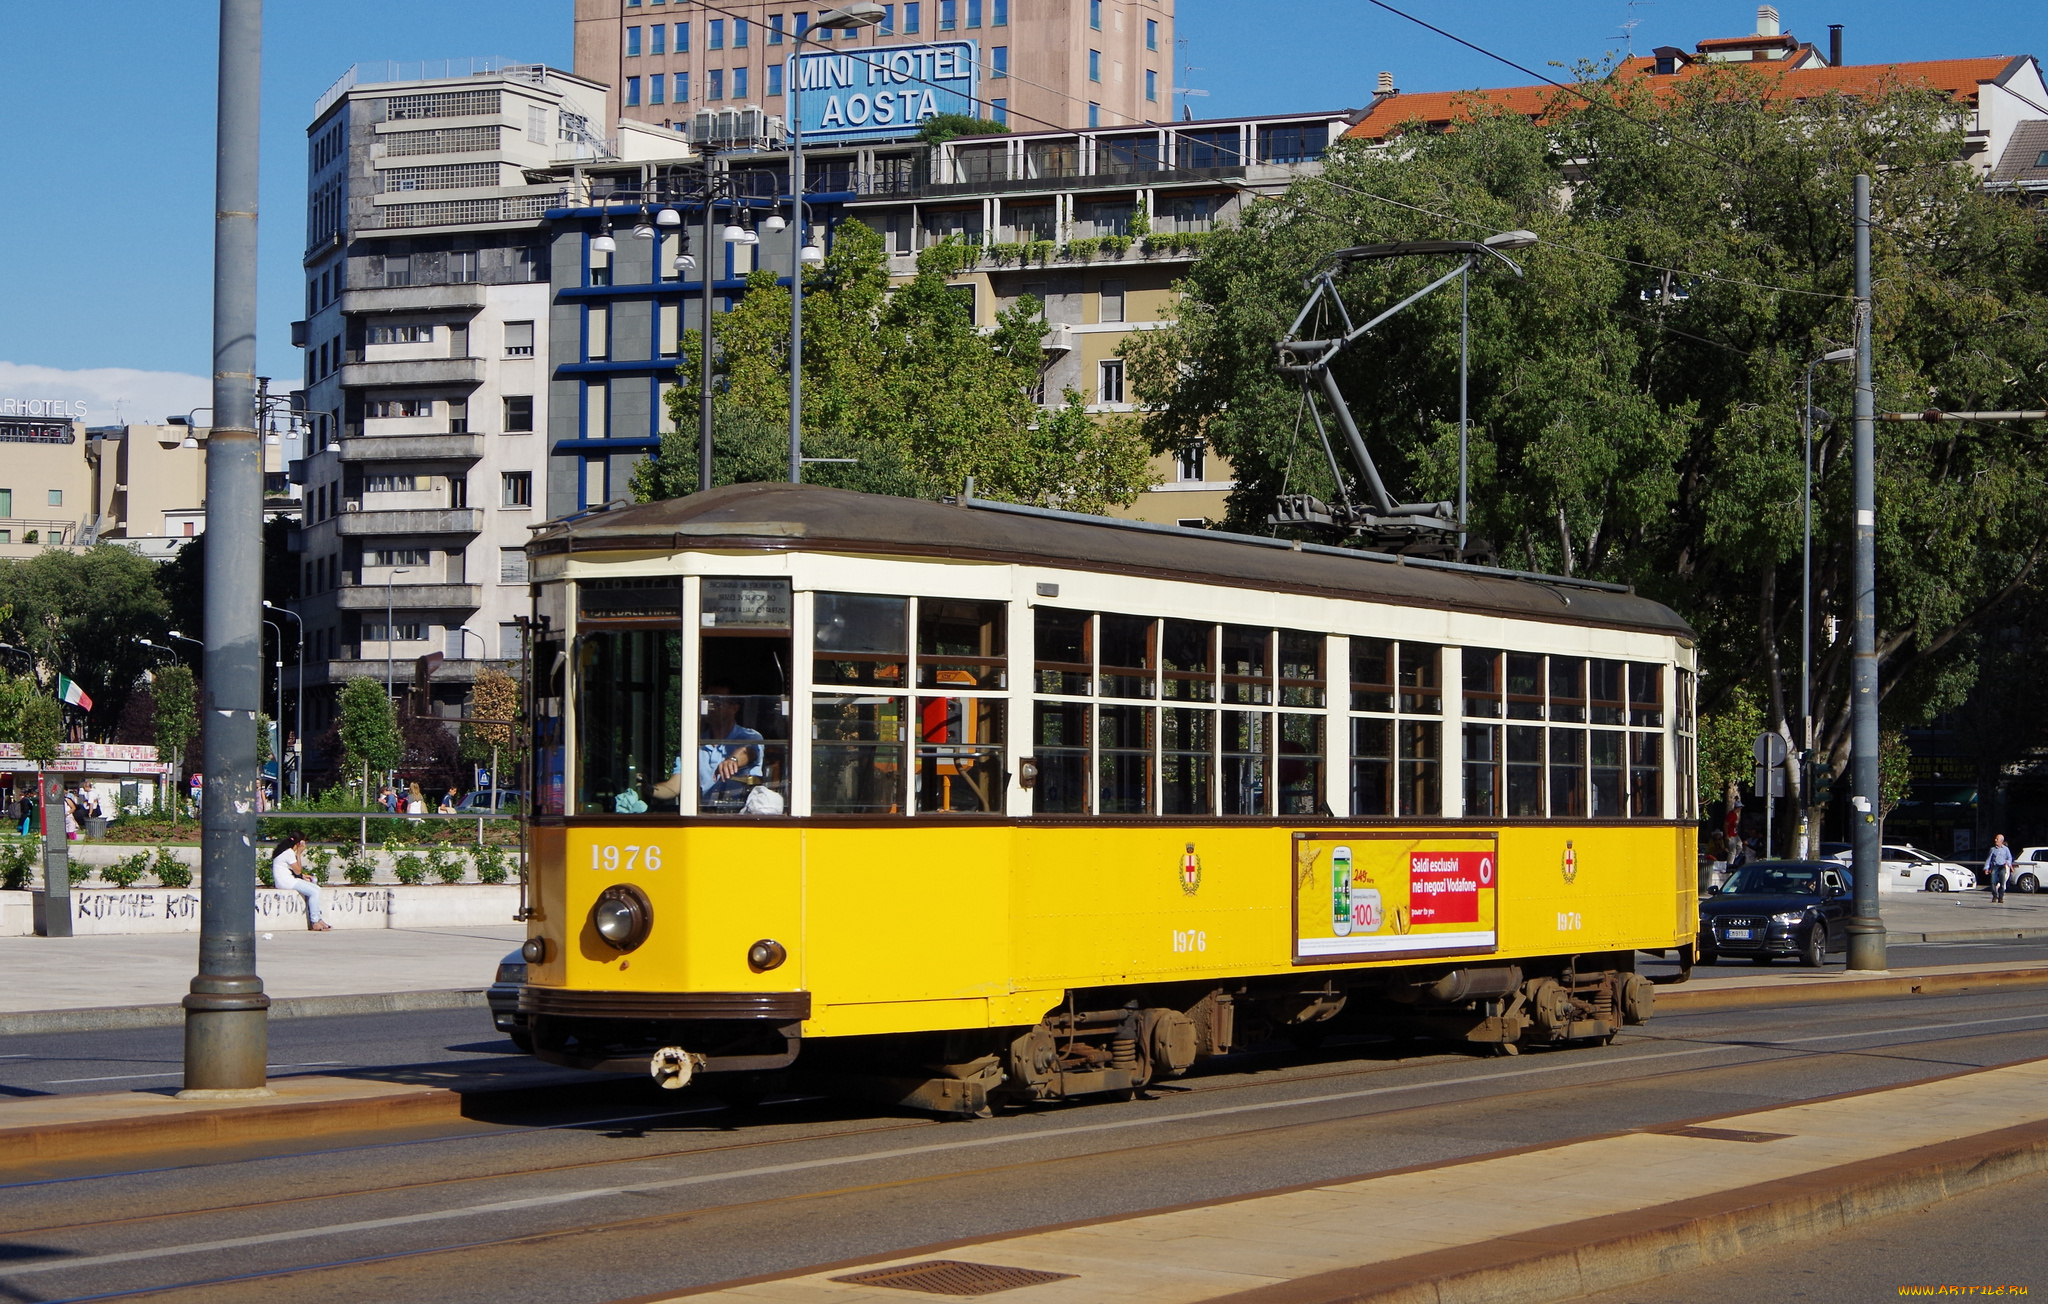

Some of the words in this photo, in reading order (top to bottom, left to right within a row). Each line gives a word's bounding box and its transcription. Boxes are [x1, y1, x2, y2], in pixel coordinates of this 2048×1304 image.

[791, 53, 853, 90] MINI
[868, 47, 970, 84] HOTEL
[821, 88, 939, 126] AOSTA
[592, 844, 662, 871] 1976
[1412, 857, 1430, 873] Saldi
[1430, 857, 1459, 872] esclusivi
[1412, 878, 1423, 893] nei
[1424, 878, 1446, 896] negozi
[1446, 877, 1477, 893] Vodafone
[1352, 904, 1372, 926] -100
[1557, 911, 1581, 931] 1976
[1173, 929, 1206, 953] 1976
